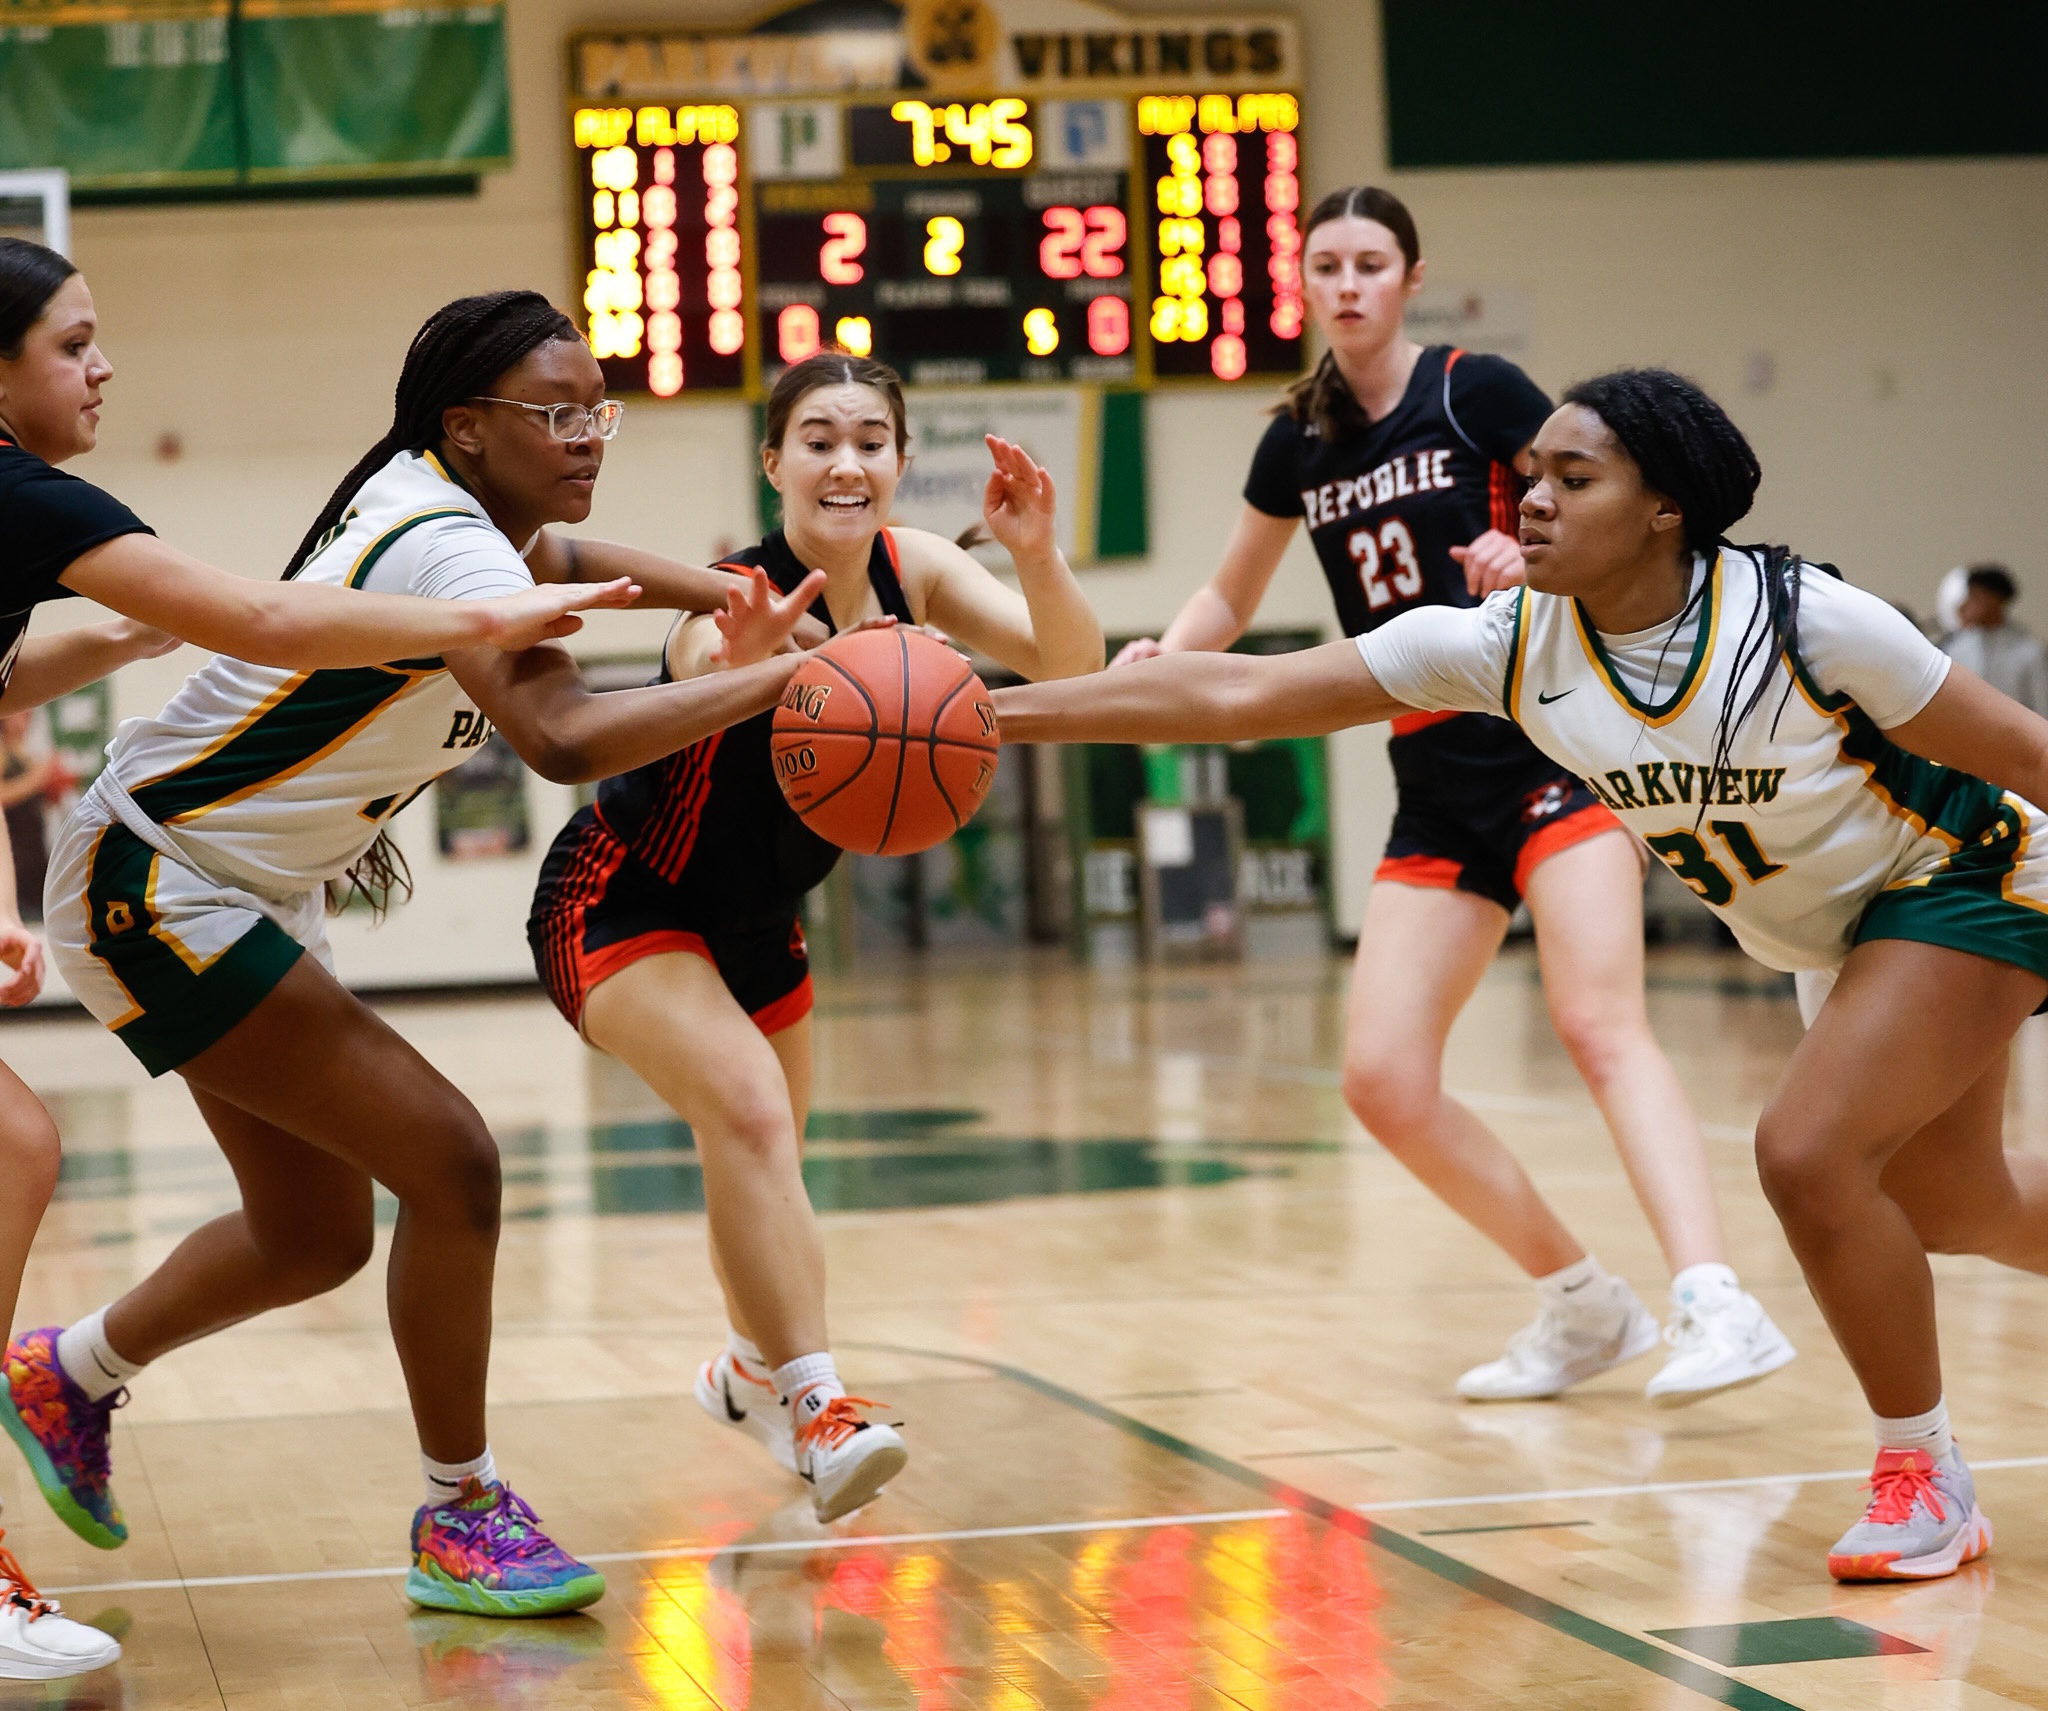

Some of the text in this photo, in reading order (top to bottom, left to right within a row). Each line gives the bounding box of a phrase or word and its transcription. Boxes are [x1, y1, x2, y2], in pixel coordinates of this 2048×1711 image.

[1012, 28, 1283, 80] VIKINGS
[892, 98, 1033, 168] 7:45
[820, 212, 867, 285] 2
[924, 216, 965, 276] 2
[1040, 206, 1126, 279] 22
[778, 304, 820, 365] 0
[1088, 295, 1130, 356] 0
[1301, 448, 1455, 532] REPUBLIC
[1346, 515, 1424, 613] 23
[1643, 819, 1789, 908] 31
